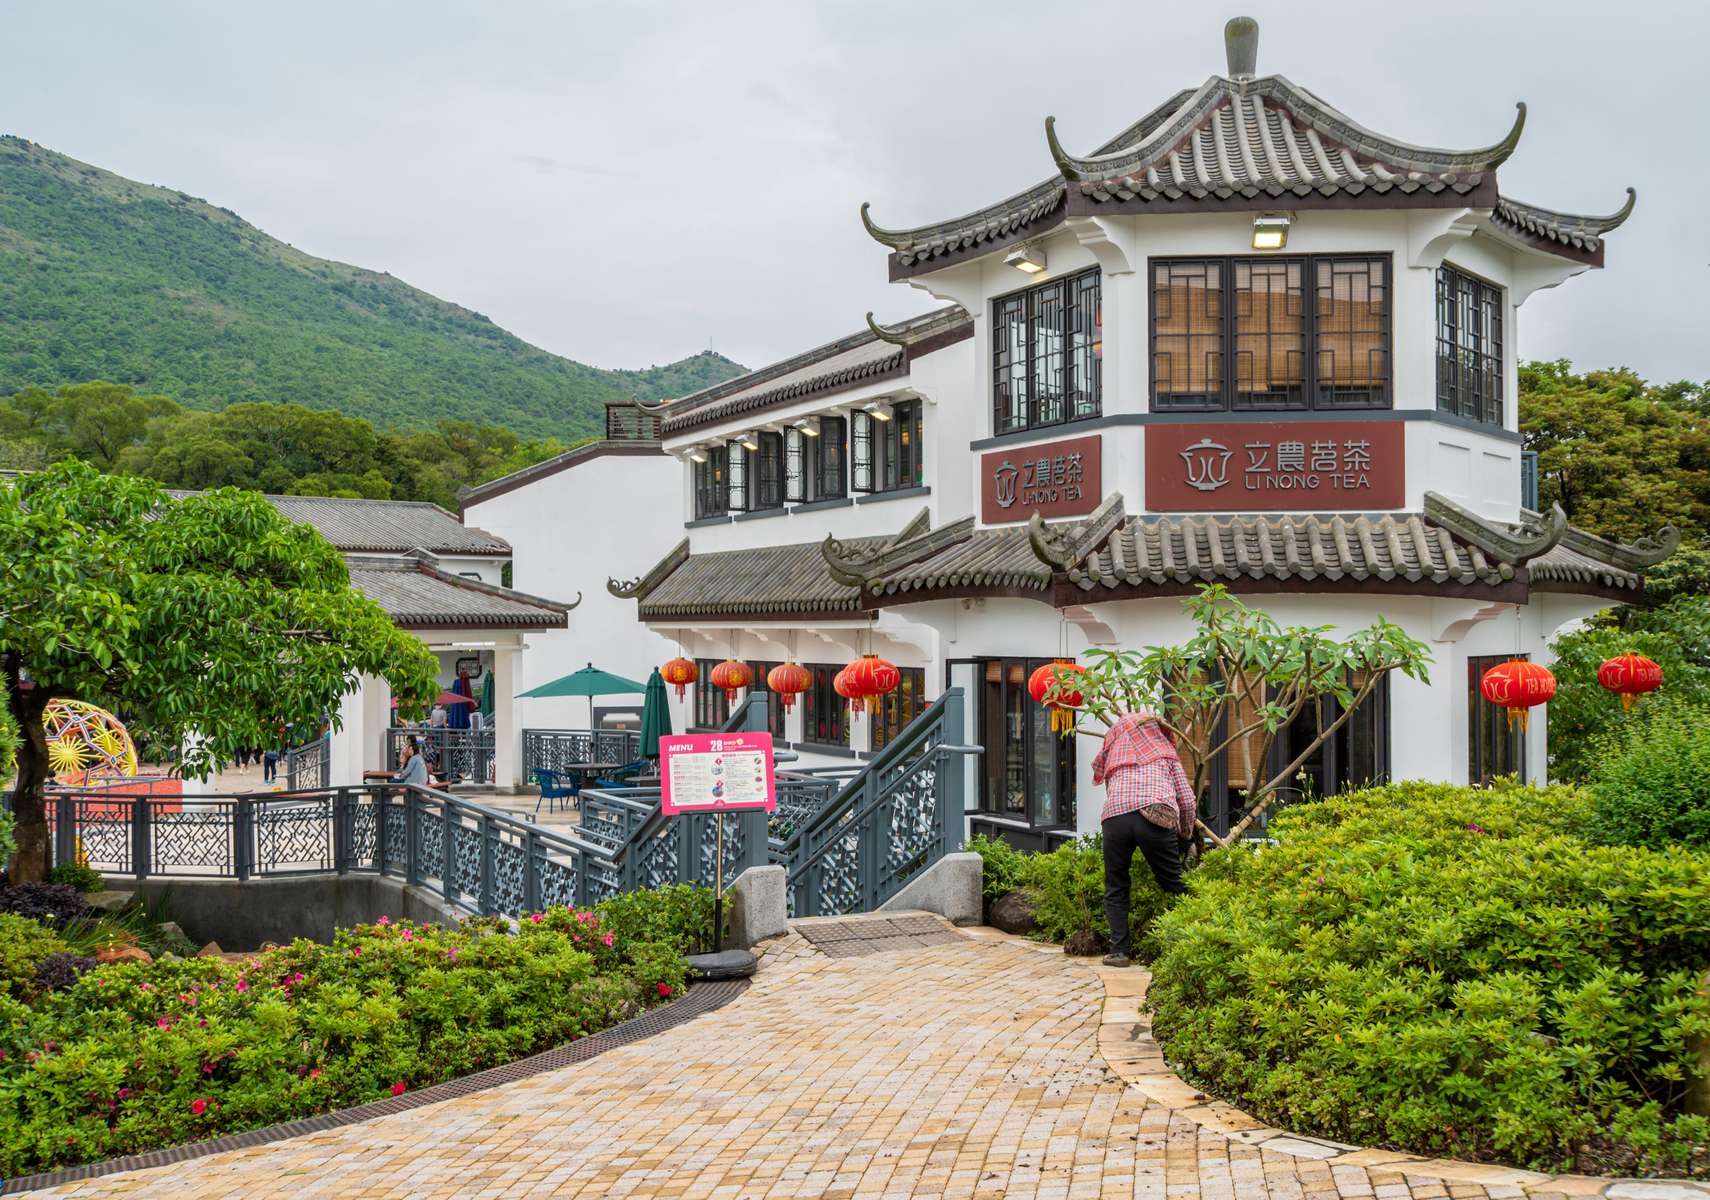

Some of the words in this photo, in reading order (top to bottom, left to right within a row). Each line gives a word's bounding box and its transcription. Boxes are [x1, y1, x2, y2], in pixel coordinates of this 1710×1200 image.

[1244, 439, 1371, 473] 立農茗茶
[1023, 452, 1082, 489] 立農茗茶
[1244, 474, 1261, 490] LI
[1265, 474, 1320, 490] NONG
[1329, 473, 1371, 489] TEA
[1030, 488, 1058, 504] NONG
[1063, 485, 1082, 501] TEA
[1526, 678, 1538, 694] TEA
[668, 744, 694, 752] MENU
[710, 739, 723, 752] 28
